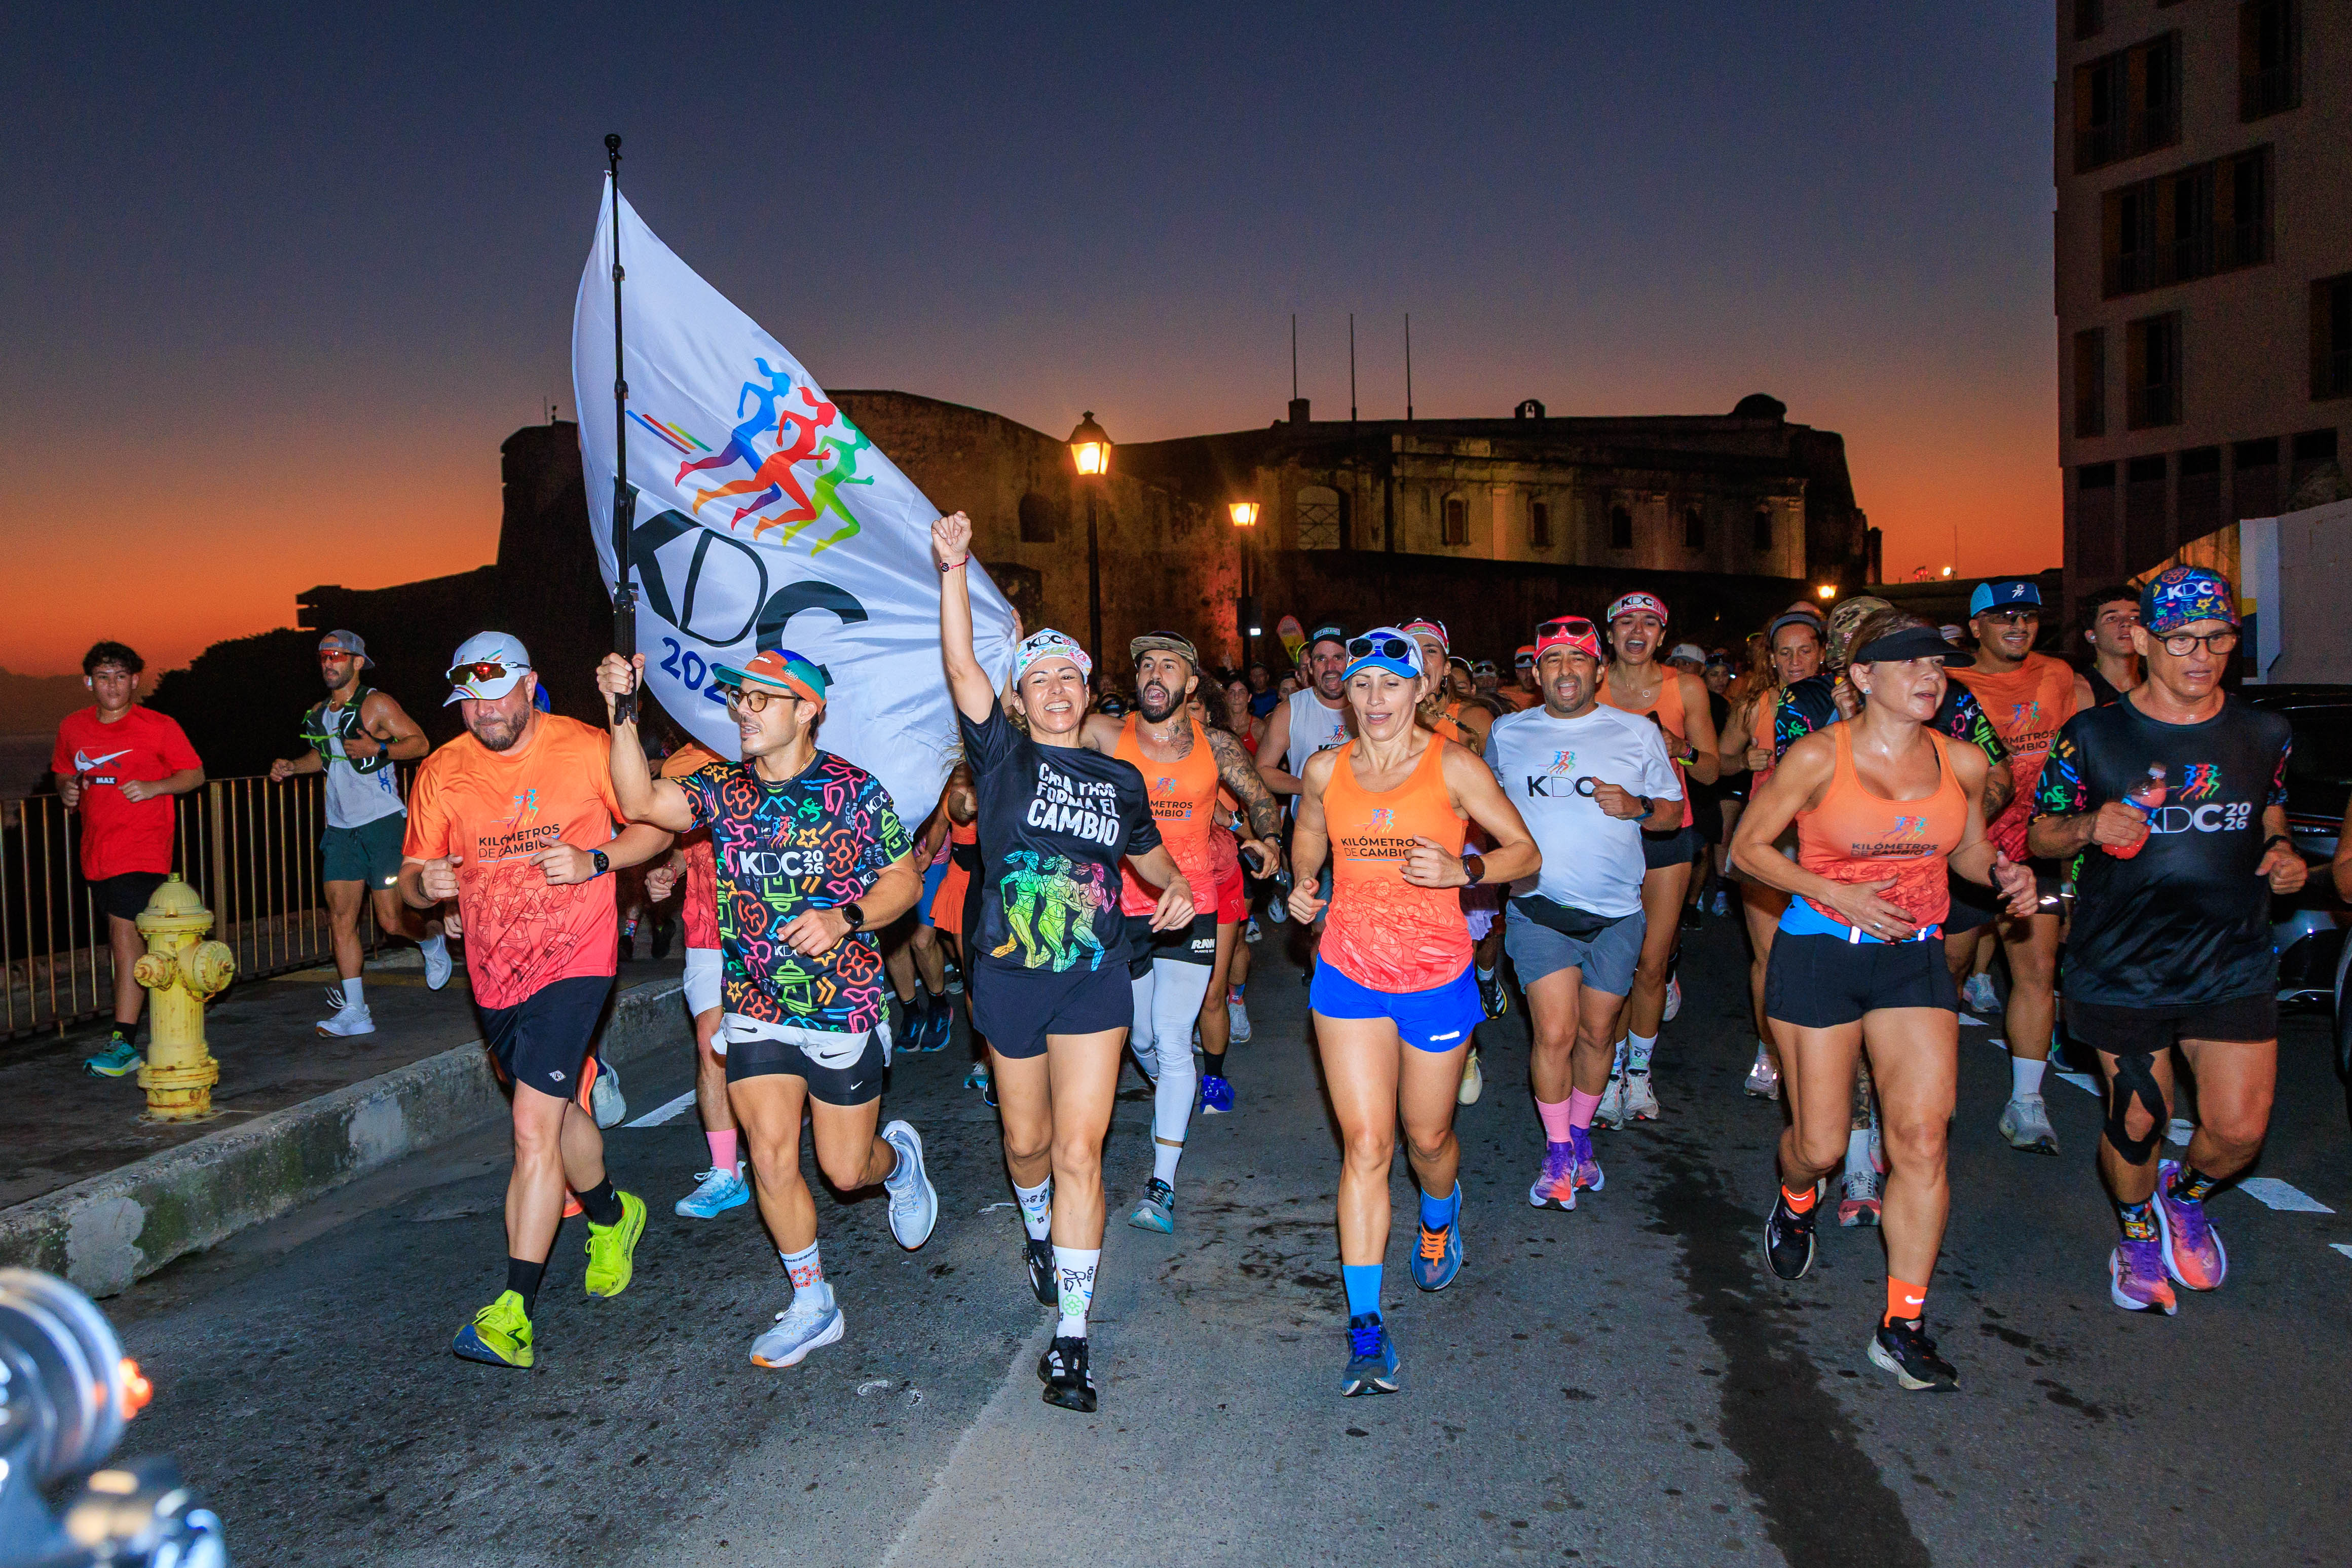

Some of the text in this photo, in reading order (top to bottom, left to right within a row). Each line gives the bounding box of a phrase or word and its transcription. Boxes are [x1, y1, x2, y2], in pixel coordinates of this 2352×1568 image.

[612, 476, 868, 687] KDC
[2167, 580, 2213, 600] KDC
[1621, 596, 1653, 608] KDC
[1026, 635, 1063, 651] KDC
[660, 637, 728, 706] 202
[2003, 730, 2055, 743] METROS
[2017, 741, 2047, 752] MBIO
[1527, 776, 1593, 798] KDC
[865, 791, 887, 814] KDC
[1100, 798, 1121, 819] EL
[1150, 800, 1193, 809] METROS
[2225, 803, 2251, 817] 20
[1027, 799, 1119, 846] CAMBIO
[2150, 804, 2224, 834] DC
[2223, 816, 2248, 831] 26
[479, 824, 561, 846] KILÓMETROS
[1341, 836, 1421, 847] KILÓMETRO
[478, 848, 496, 858] DE
[802, 849, 824, 863] 20
[1344, 848, 1359, 856] DE
[739, 851, 803, 876] KDC
[803, 862, 825, 874] 26
[860, 870, 878, 886] KD
[1191, 939, 1215, 949] RAW
[782, 1246, 817, 1263] PRESSPO
